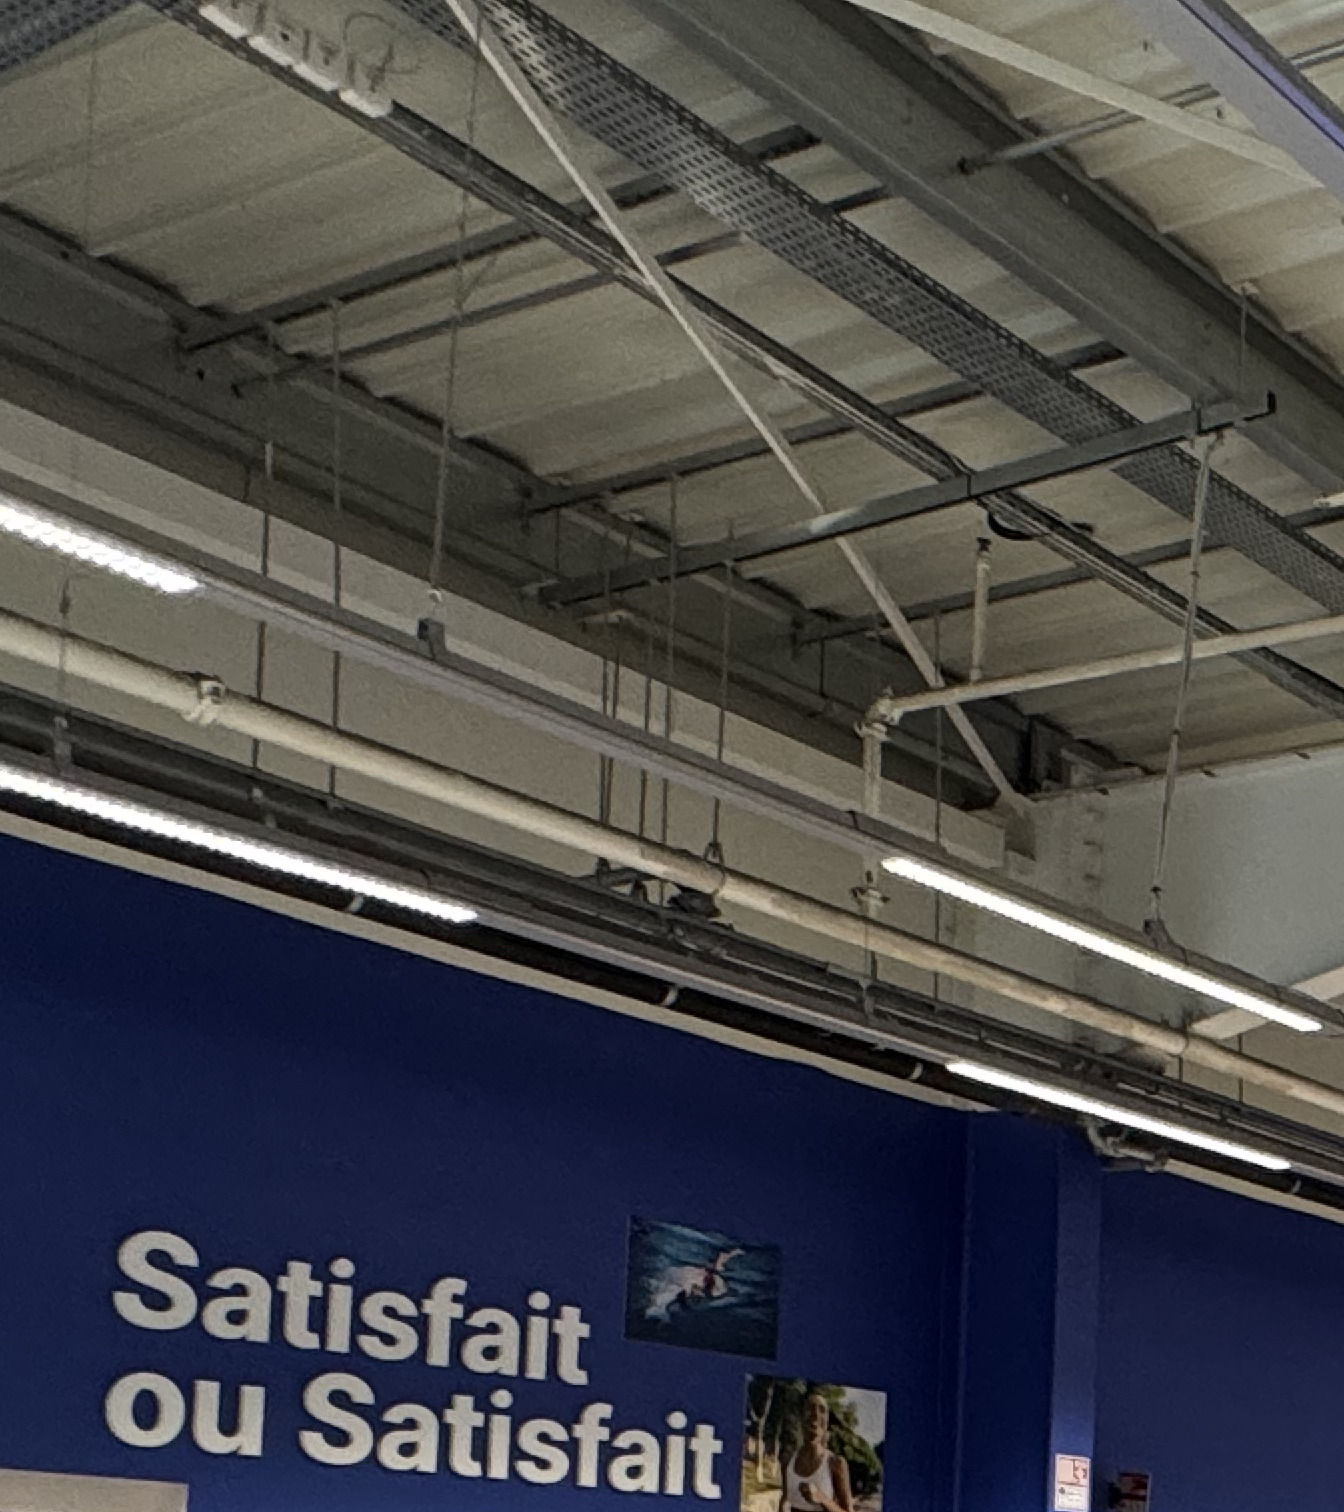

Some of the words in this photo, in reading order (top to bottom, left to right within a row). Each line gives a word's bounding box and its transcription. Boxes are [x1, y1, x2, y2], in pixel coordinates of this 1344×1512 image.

[112, 1230, 589, 1385] Satisfait
[105, 1371, 265, 1457] ou
[298, 1371, 723, 1500] Satisfait
